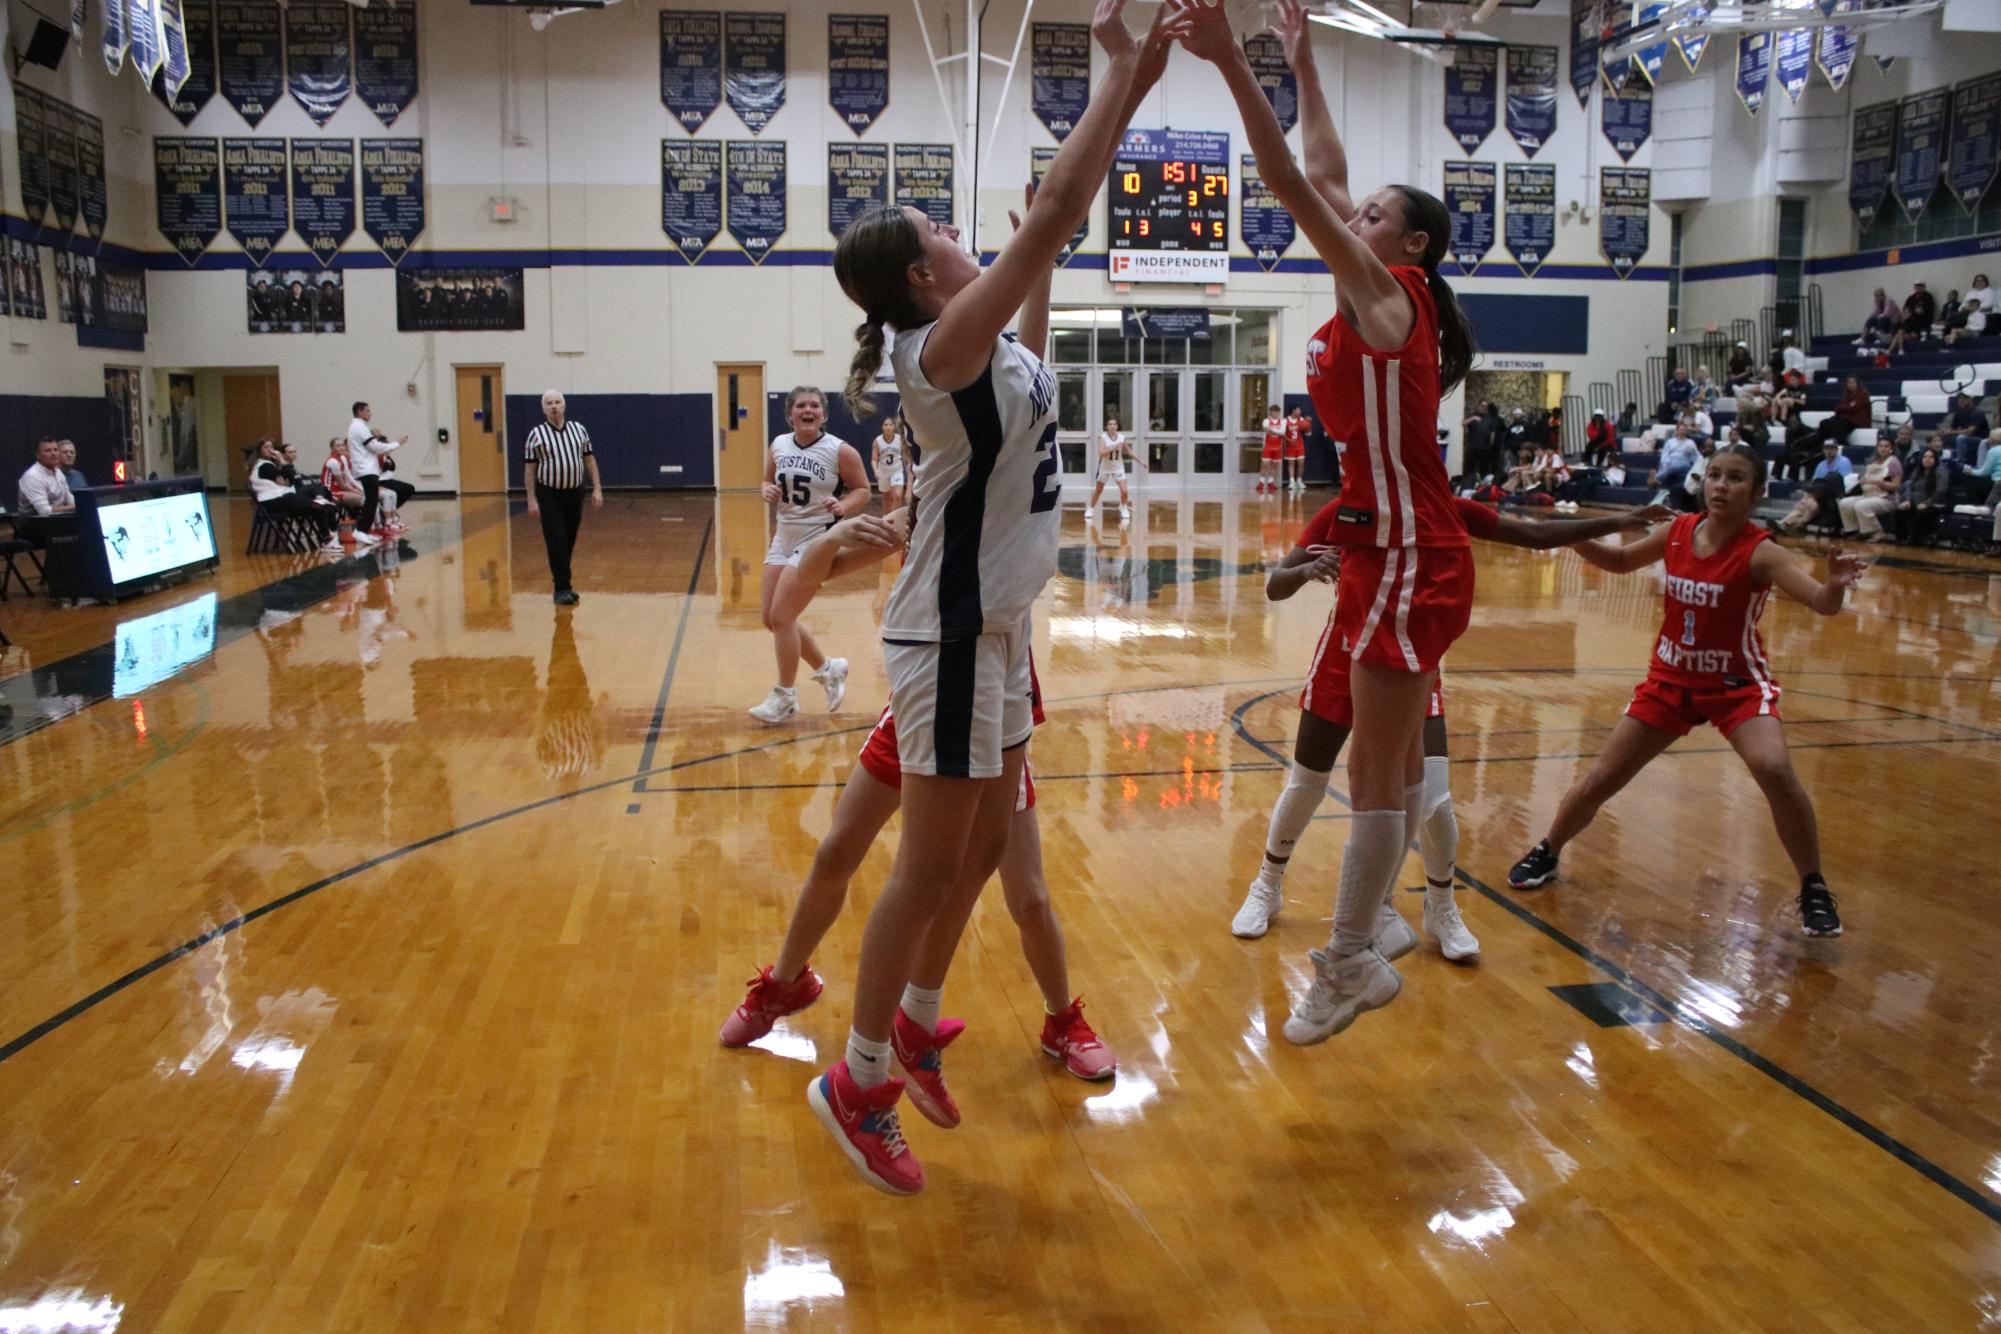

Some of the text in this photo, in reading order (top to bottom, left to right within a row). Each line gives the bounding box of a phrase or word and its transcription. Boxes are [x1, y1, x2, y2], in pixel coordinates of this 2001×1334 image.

[1117, 143, 1166, 154] ARMERS
[692, 147, 720, 163] STATE
[728, 149, 745, 163] 4TH
[756, 148, 784, 164] STATE
[244, 165, 261, 174] TAPPS
[311, 166, 327, 174] TAPPS
[381, 166, 397, 174] TAPPS
[1115, 161, 1137, 171] Home
[1162, 161, 1197, 183] 1:51
[1201, 164, 1226, 175] Guests
[671, 170, 713, 179] Wrestling
[735, 172, 777, 180] Wrestling
[846, 169, 862, 178] TAPPS
[743, 180, 770, 194] 2014
[1123, 173, 1141, 194] 10
[1203, 175, 1228, 196] 27
[1158, 194, 1183, 204] period
[1187, 189, 1198, 207] 3
[1114, 207, 1132, 217] fouls
[1158, 208, 1182, 218] player
[1208, 209, 1225, 219] fouls
[1124, 220, 1130, 234] 1
[1139, 219, 1150, 236] 3
[1190, 221, 1202, 237] 4
[1212, 221, 1224, 238] 5
[1160, 240, 1179, 250] game
[1135, 256, 1226, 268] INDEPENDENT
[1135, 268, 1190, 276] FINANCIAL
[1493, 360, 1545, 369] RESTROOMS
[885, 454, 894, 466] 3
[777, 456, 826, 481] MUSTANGS
[777, 472, 811, 506] 15
[1667, 574, 1725, 609] FIRST
[1681, 610, 1695, 646] 1
[1657, 634, 1733, 673] BAPTIST
